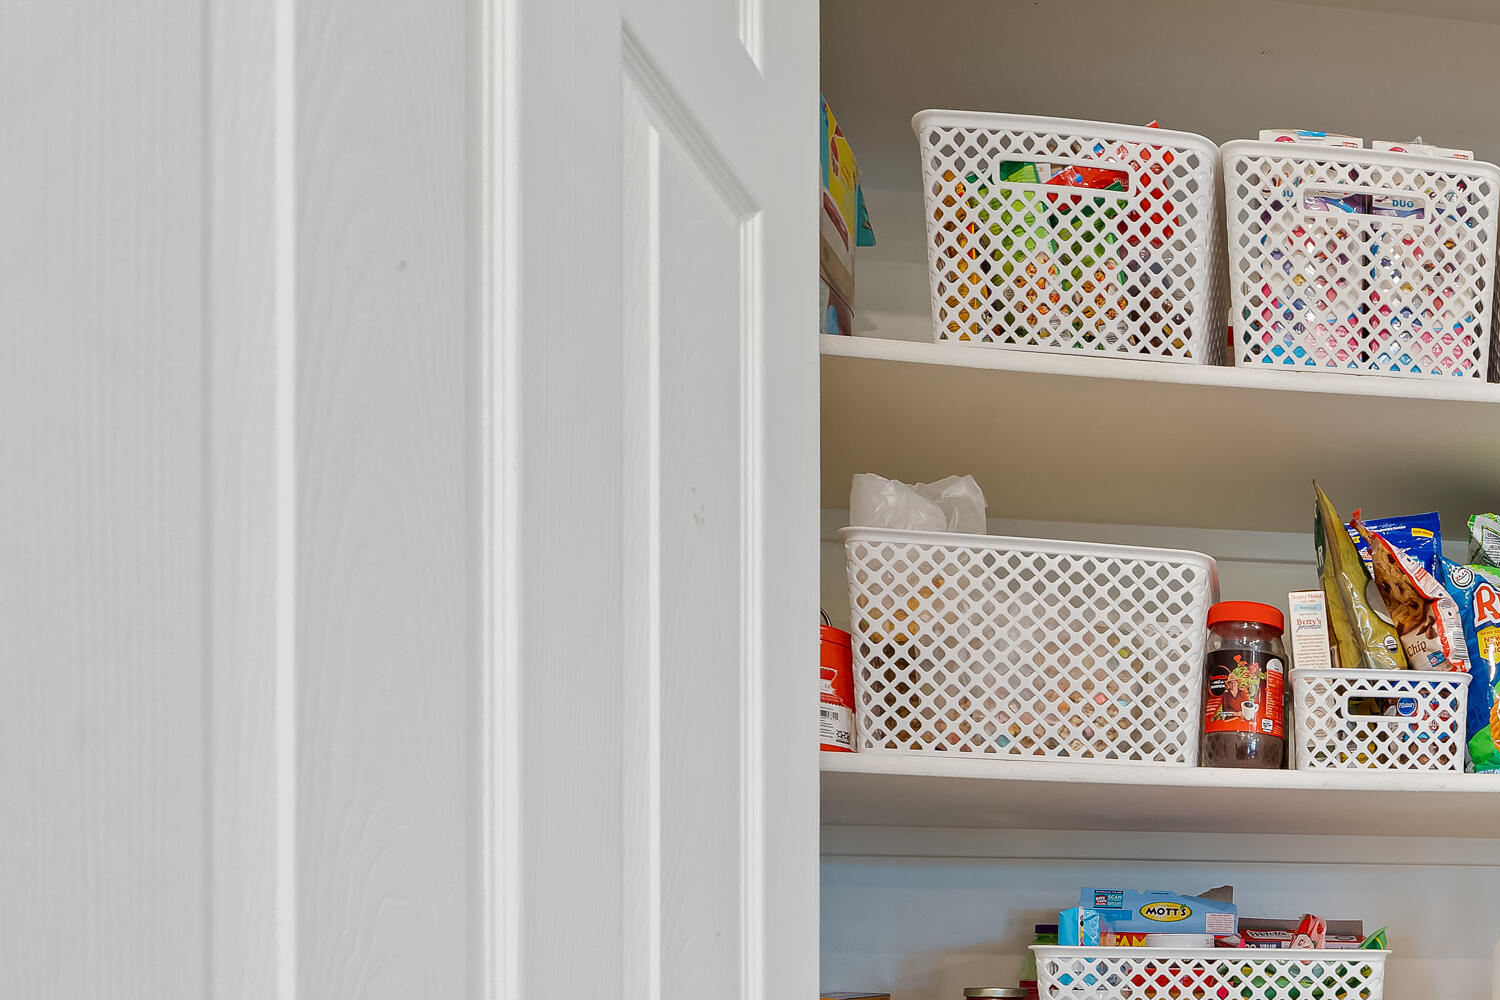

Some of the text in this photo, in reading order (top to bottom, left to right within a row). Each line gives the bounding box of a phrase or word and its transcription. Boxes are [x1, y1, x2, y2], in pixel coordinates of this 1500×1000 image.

[1391, 199, 1414, 208] DUO
[1296, 617, 1322, 626] Betty's
[1406, 641, 1427, 657] Chip
[1145, 905, 1187, 917] MOTT'S
